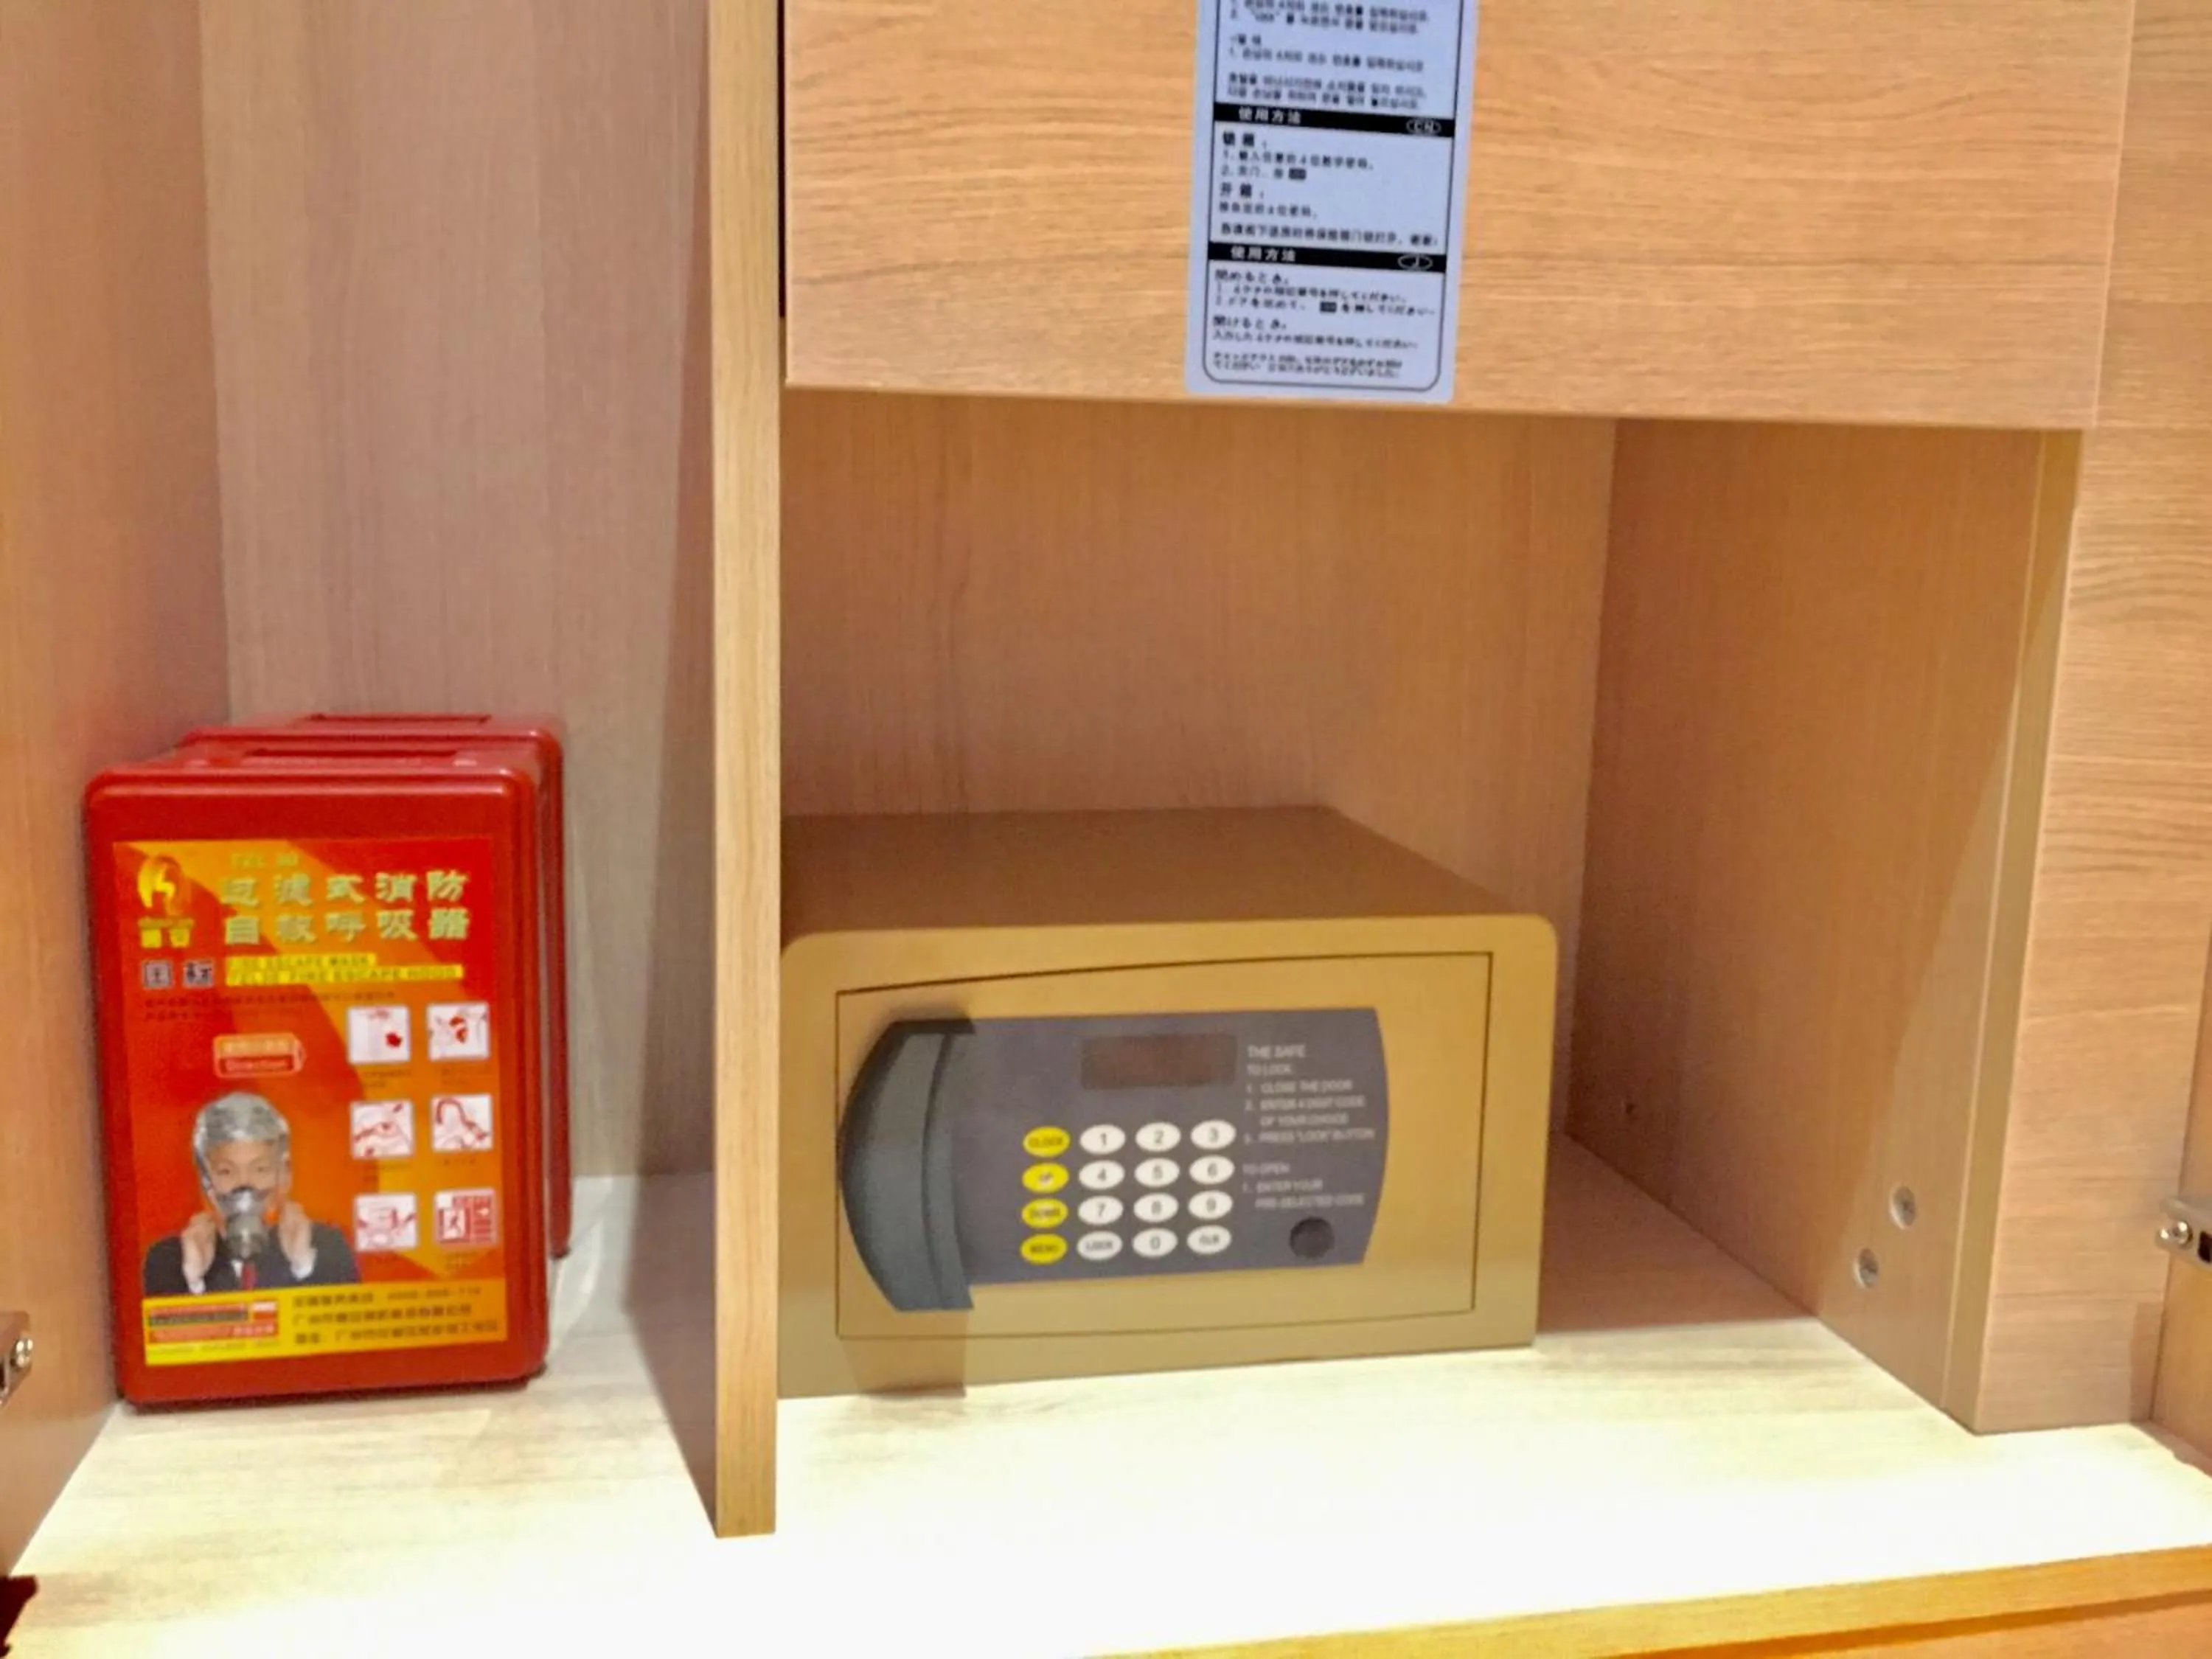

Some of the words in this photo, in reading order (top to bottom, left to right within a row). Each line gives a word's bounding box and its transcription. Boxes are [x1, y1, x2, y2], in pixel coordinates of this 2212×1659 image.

[1238, 106, 1302, 125] 使用方法
[1230, 246, 1297, 263] 使用方法
[1247, 1044, 1271, 1059] THE
[1273, 1043, 1306, 1058] SAFE
[1099, 1133, 1107, 1147] 1
[1154, 1130, 1164, 1144] 2
[1208, 1127, 1219, 1142] 3
[1096, 1167, 1107, 1181] 4
[1152, 1165, 1164, 1180] 5
[1206, 1162, 1217, 1178] 6
[1096, 1203, 1107, 1217] 7
[1151, 1200, 1162, 1216] 8
[1206, 1197, 1217, 1213] 9
[1085, 1239, 1113, 1251] LOCK
[1150, 1236, 1161, 1251] 0
